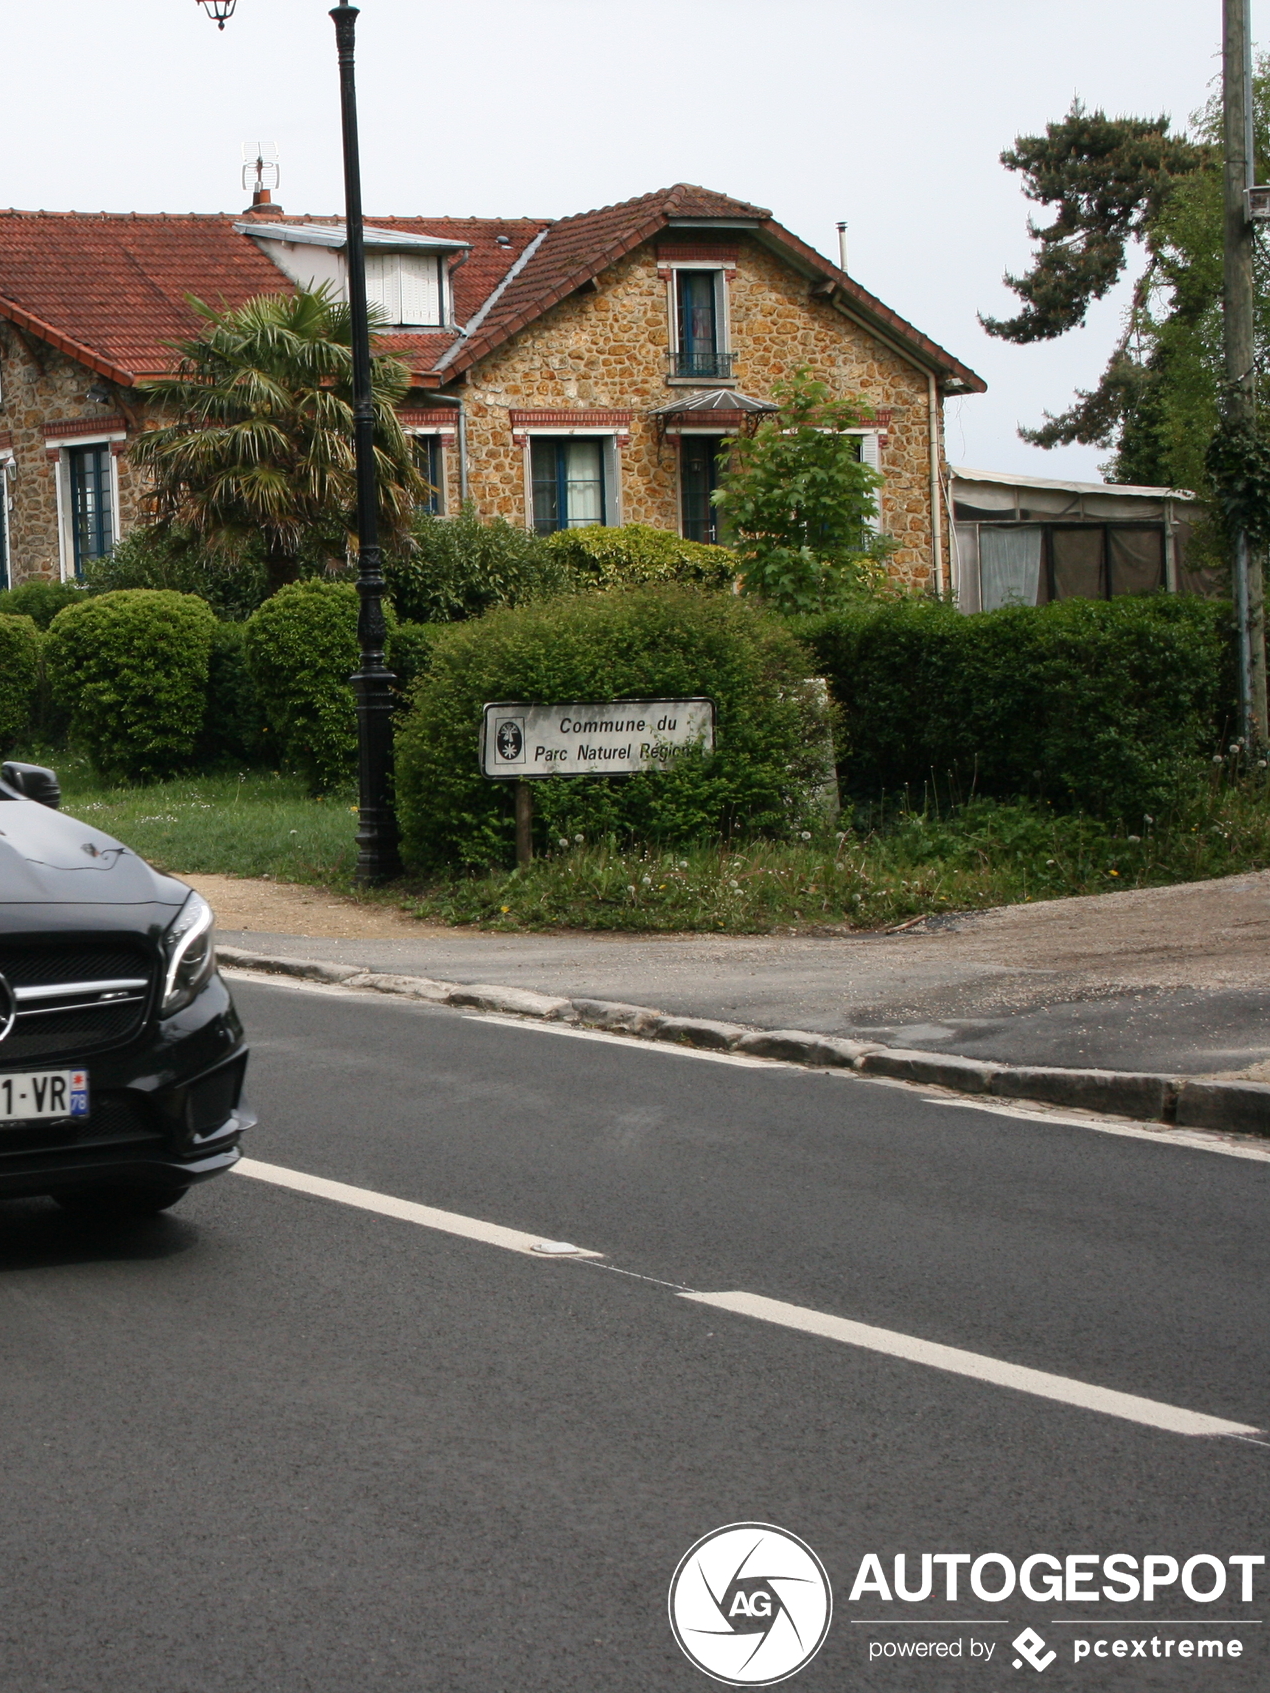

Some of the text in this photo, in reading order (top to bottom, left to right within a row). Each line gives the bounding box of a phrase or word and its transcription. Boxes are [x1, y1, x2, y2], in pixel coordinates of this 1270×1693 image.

[559, 715, 678, 734] Commune du
[534, 742, 702, 763] Parc Naturel Région
[71, 1094, 87, 1111] 78
